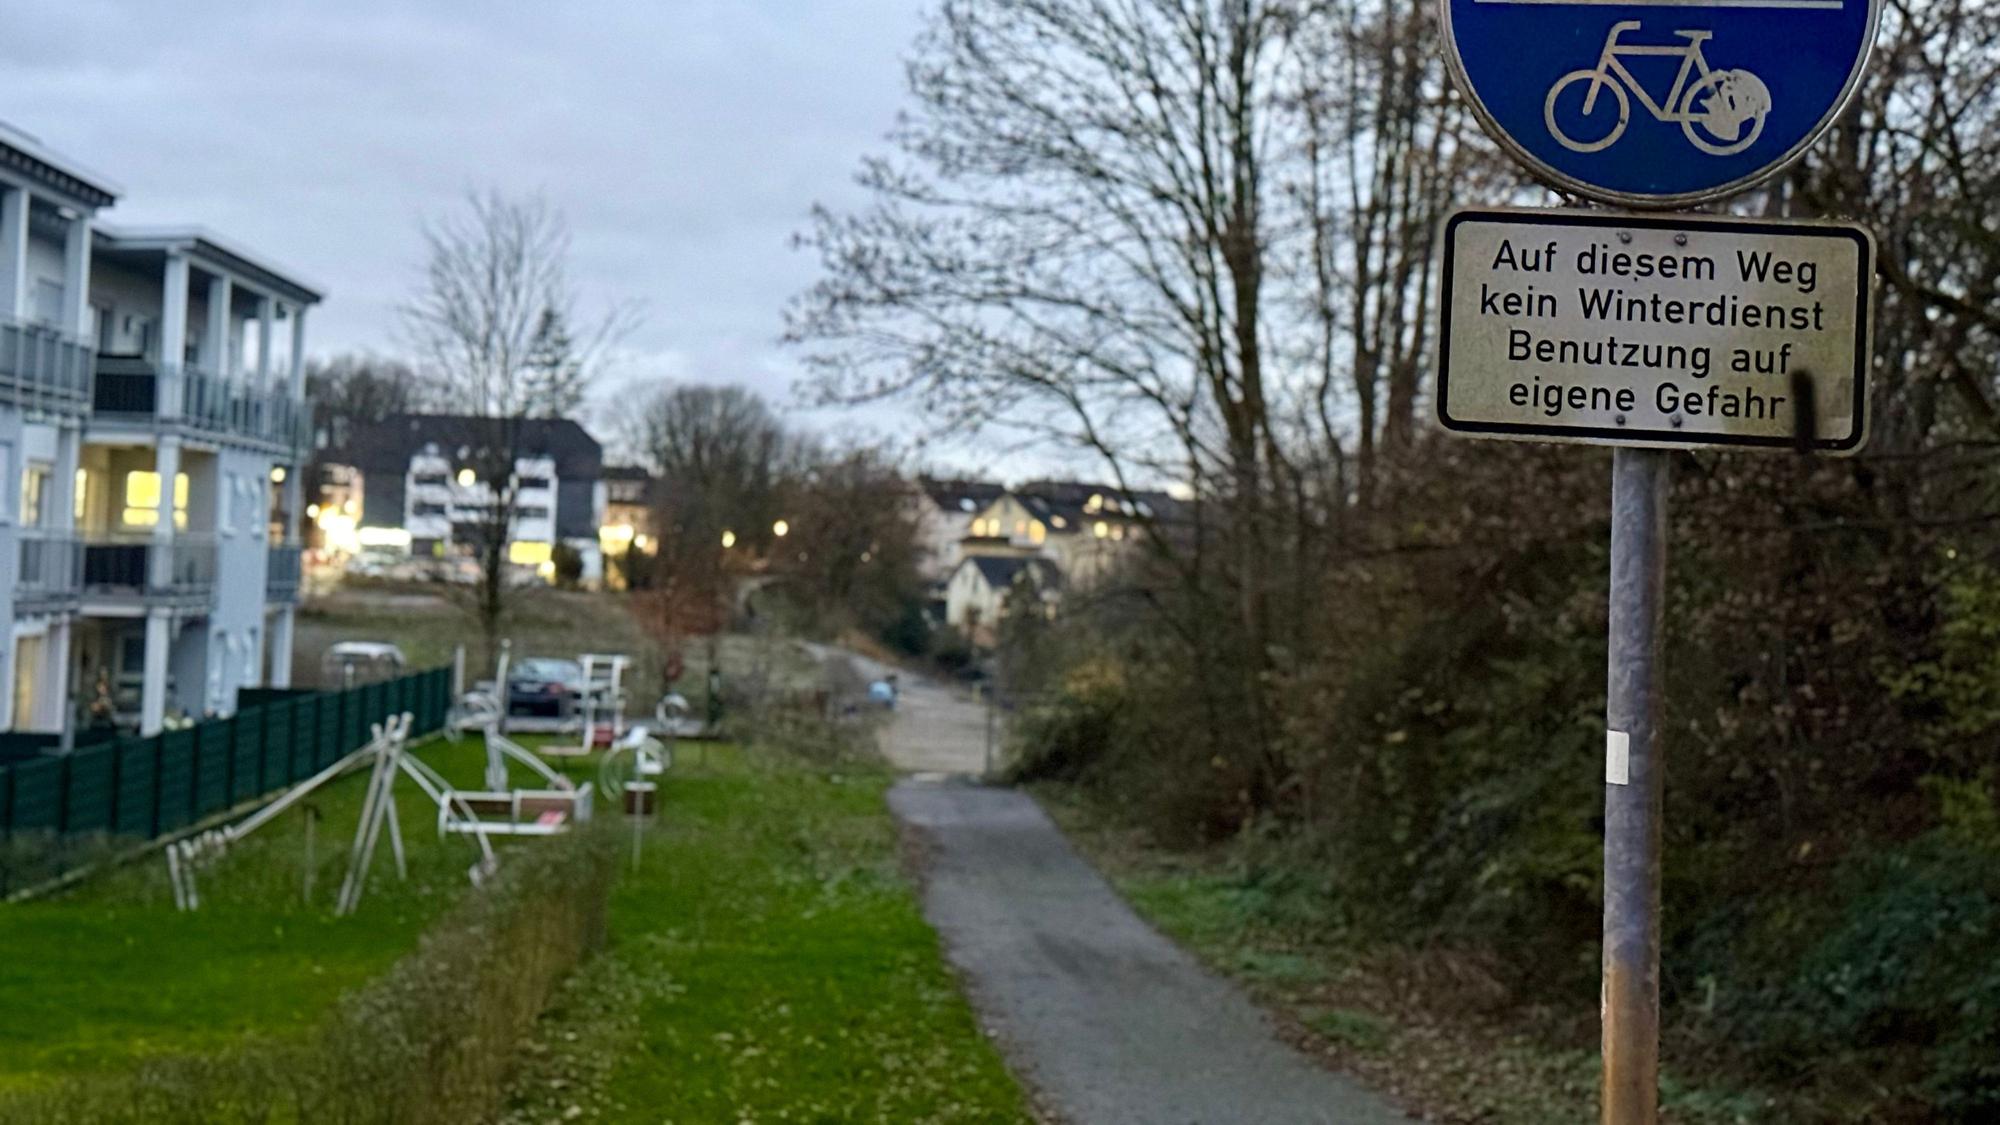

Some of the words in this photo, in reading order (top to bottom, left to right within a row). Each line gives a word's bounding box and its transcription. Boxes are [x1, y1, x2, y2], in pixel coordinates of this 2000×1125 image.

[1492, 240, 1558, 273] Auf
[1577, 244, 1715, 280] diesem
[1737, 251, 1817, 292] Weg
[1480, 284, 1557, 318] kein
[1579, 289, 1825, 331] Winterdienst
[1508, 329, 1710, 378] Benutzung
[1731, 343, 1792, 374] auf
[1509, 376, 1635, 416] eigene
[1656, 382, 1786, 419] Gefahr
